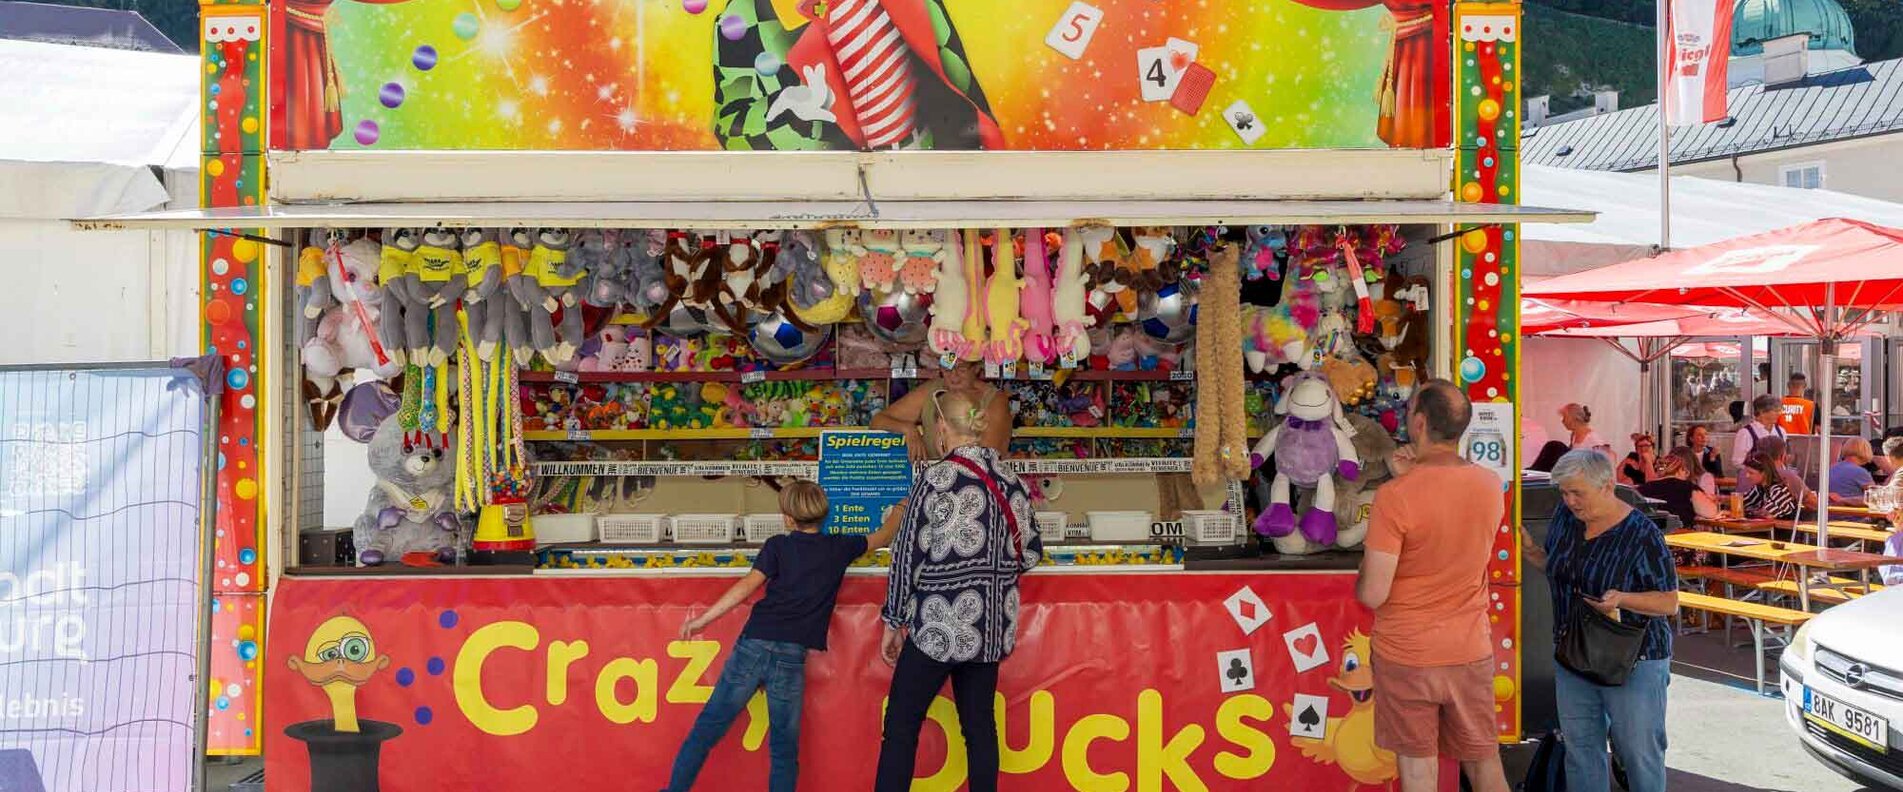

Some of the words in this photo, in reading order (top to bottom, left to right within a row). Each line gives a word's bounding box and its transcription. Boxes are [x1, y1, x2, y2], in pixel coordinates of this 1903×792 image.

[1062, 14, 1090, 42] 5
[1146, 58, 1167, 87] 4
[1781, 404, 1804, 415] CURITY
[827, 435, 906, 449] Spielregel
[1473, 441, 1501, 462] 98
[541, 464, 605, 475] WILLKOMMEN
[835, 504, 840, 513] 1
[842, 504, 865, 513] Ente
[834, 515, 840, 523] 3
[842, 515, 870, 523] Enten
[829, 526, 840, 535] 10
[841, 526, 870, 535] Enten
[1813, 694, 1835, 722] 8AK
[1844, 708, 1880, 741] 9581
